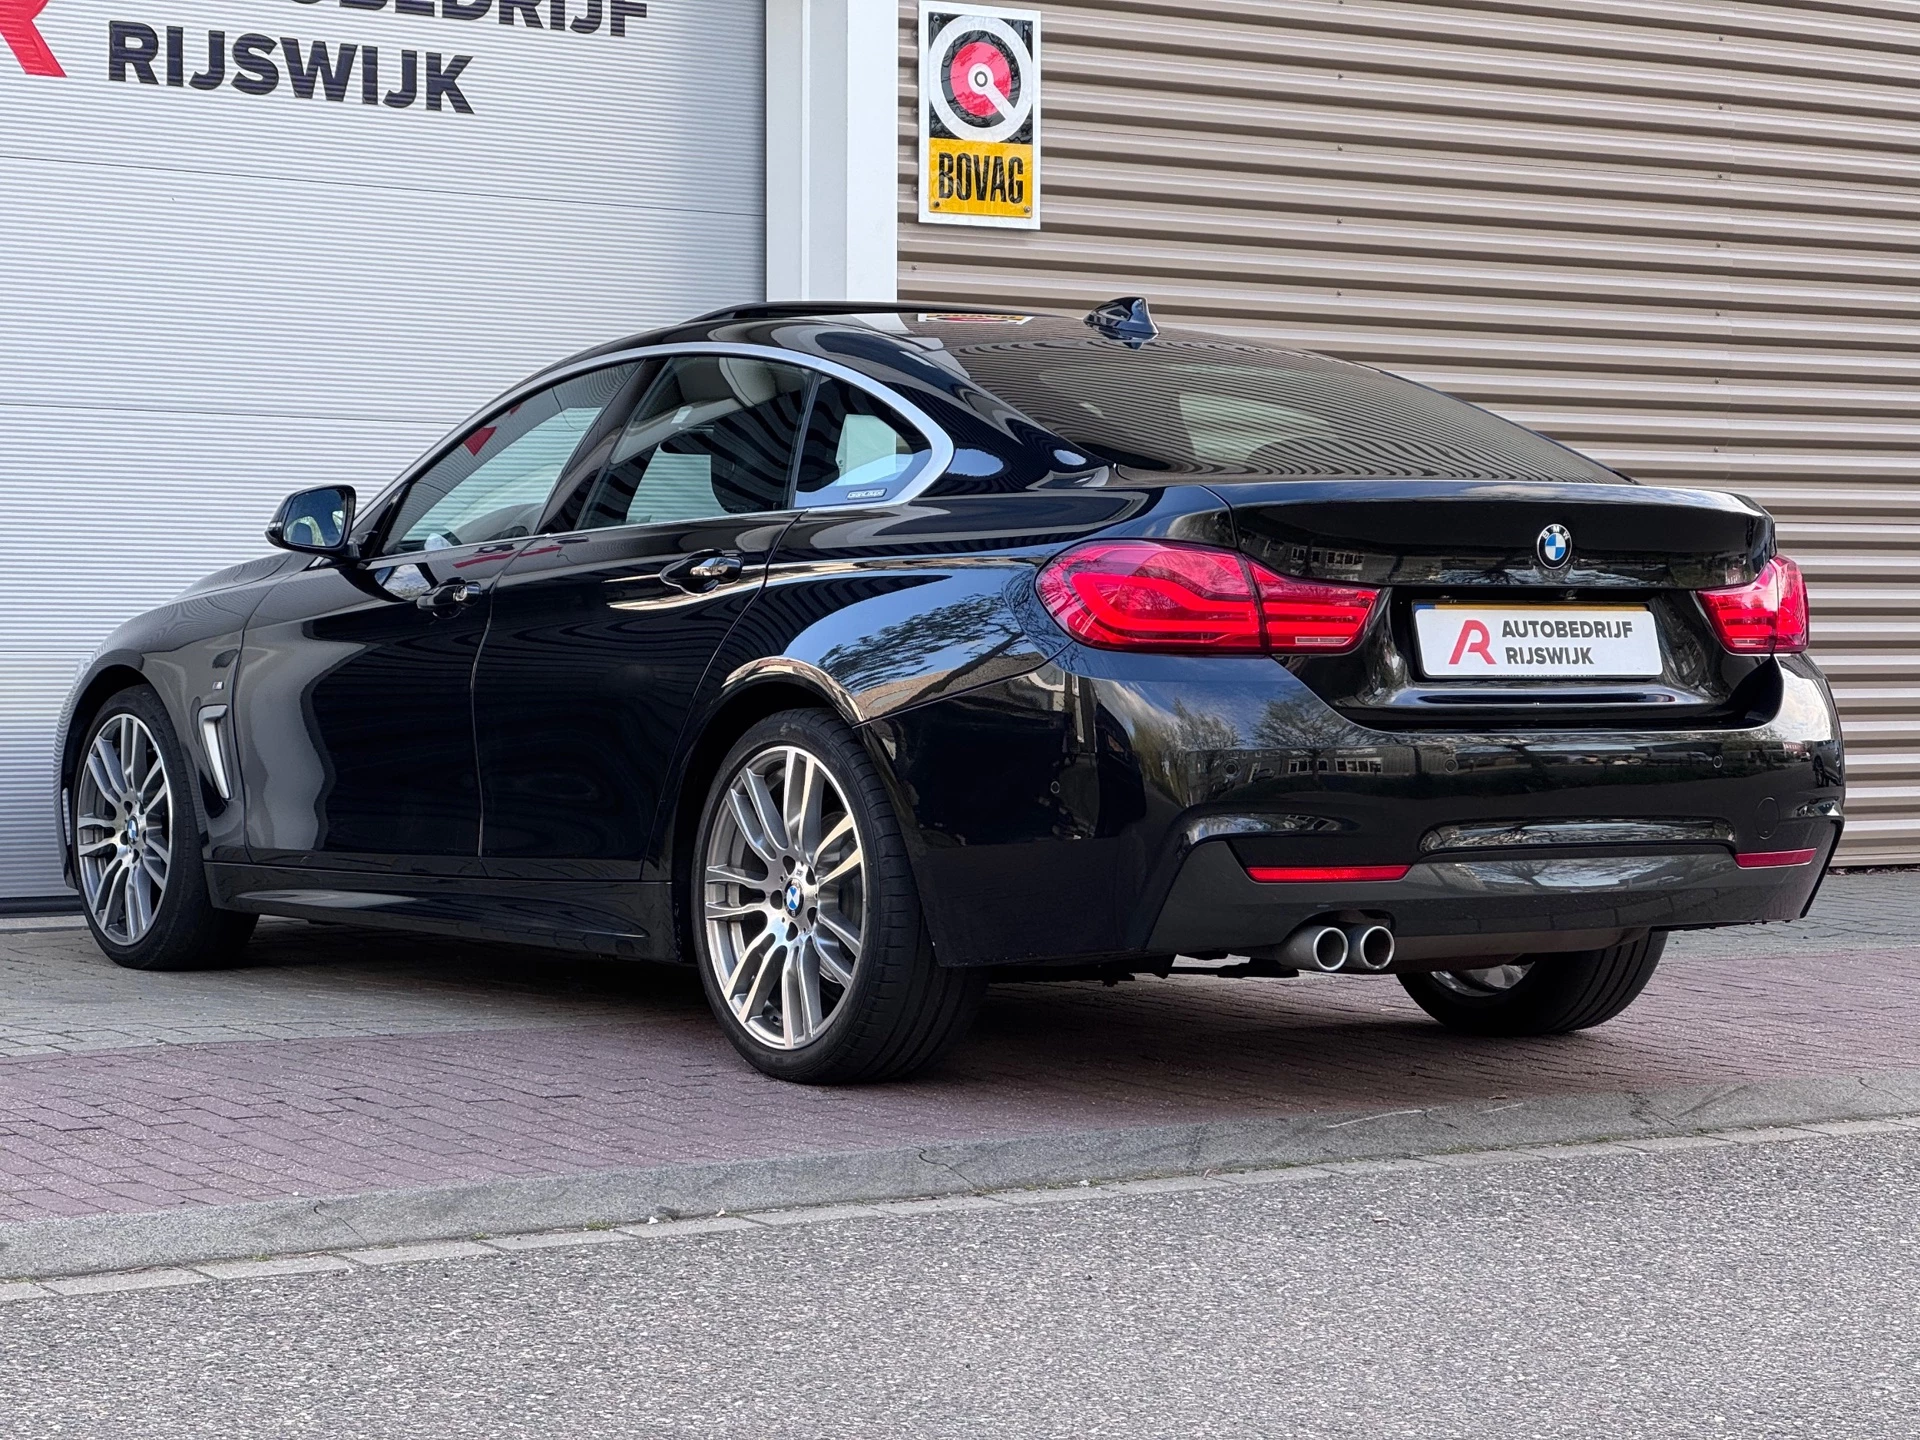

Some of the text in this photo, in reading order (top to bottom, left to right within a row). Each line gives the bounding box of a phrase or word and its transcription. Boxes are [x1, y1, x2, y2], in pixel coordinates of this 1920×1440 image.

[109, 20, 475, 114] RIJSWIJK
[938, 152, 1024, 204] BOVAG
[1502, 620, 1633, 638] AUTOBEDRIJF
[1505, 646, 1595, 665] RIJSWIJK
